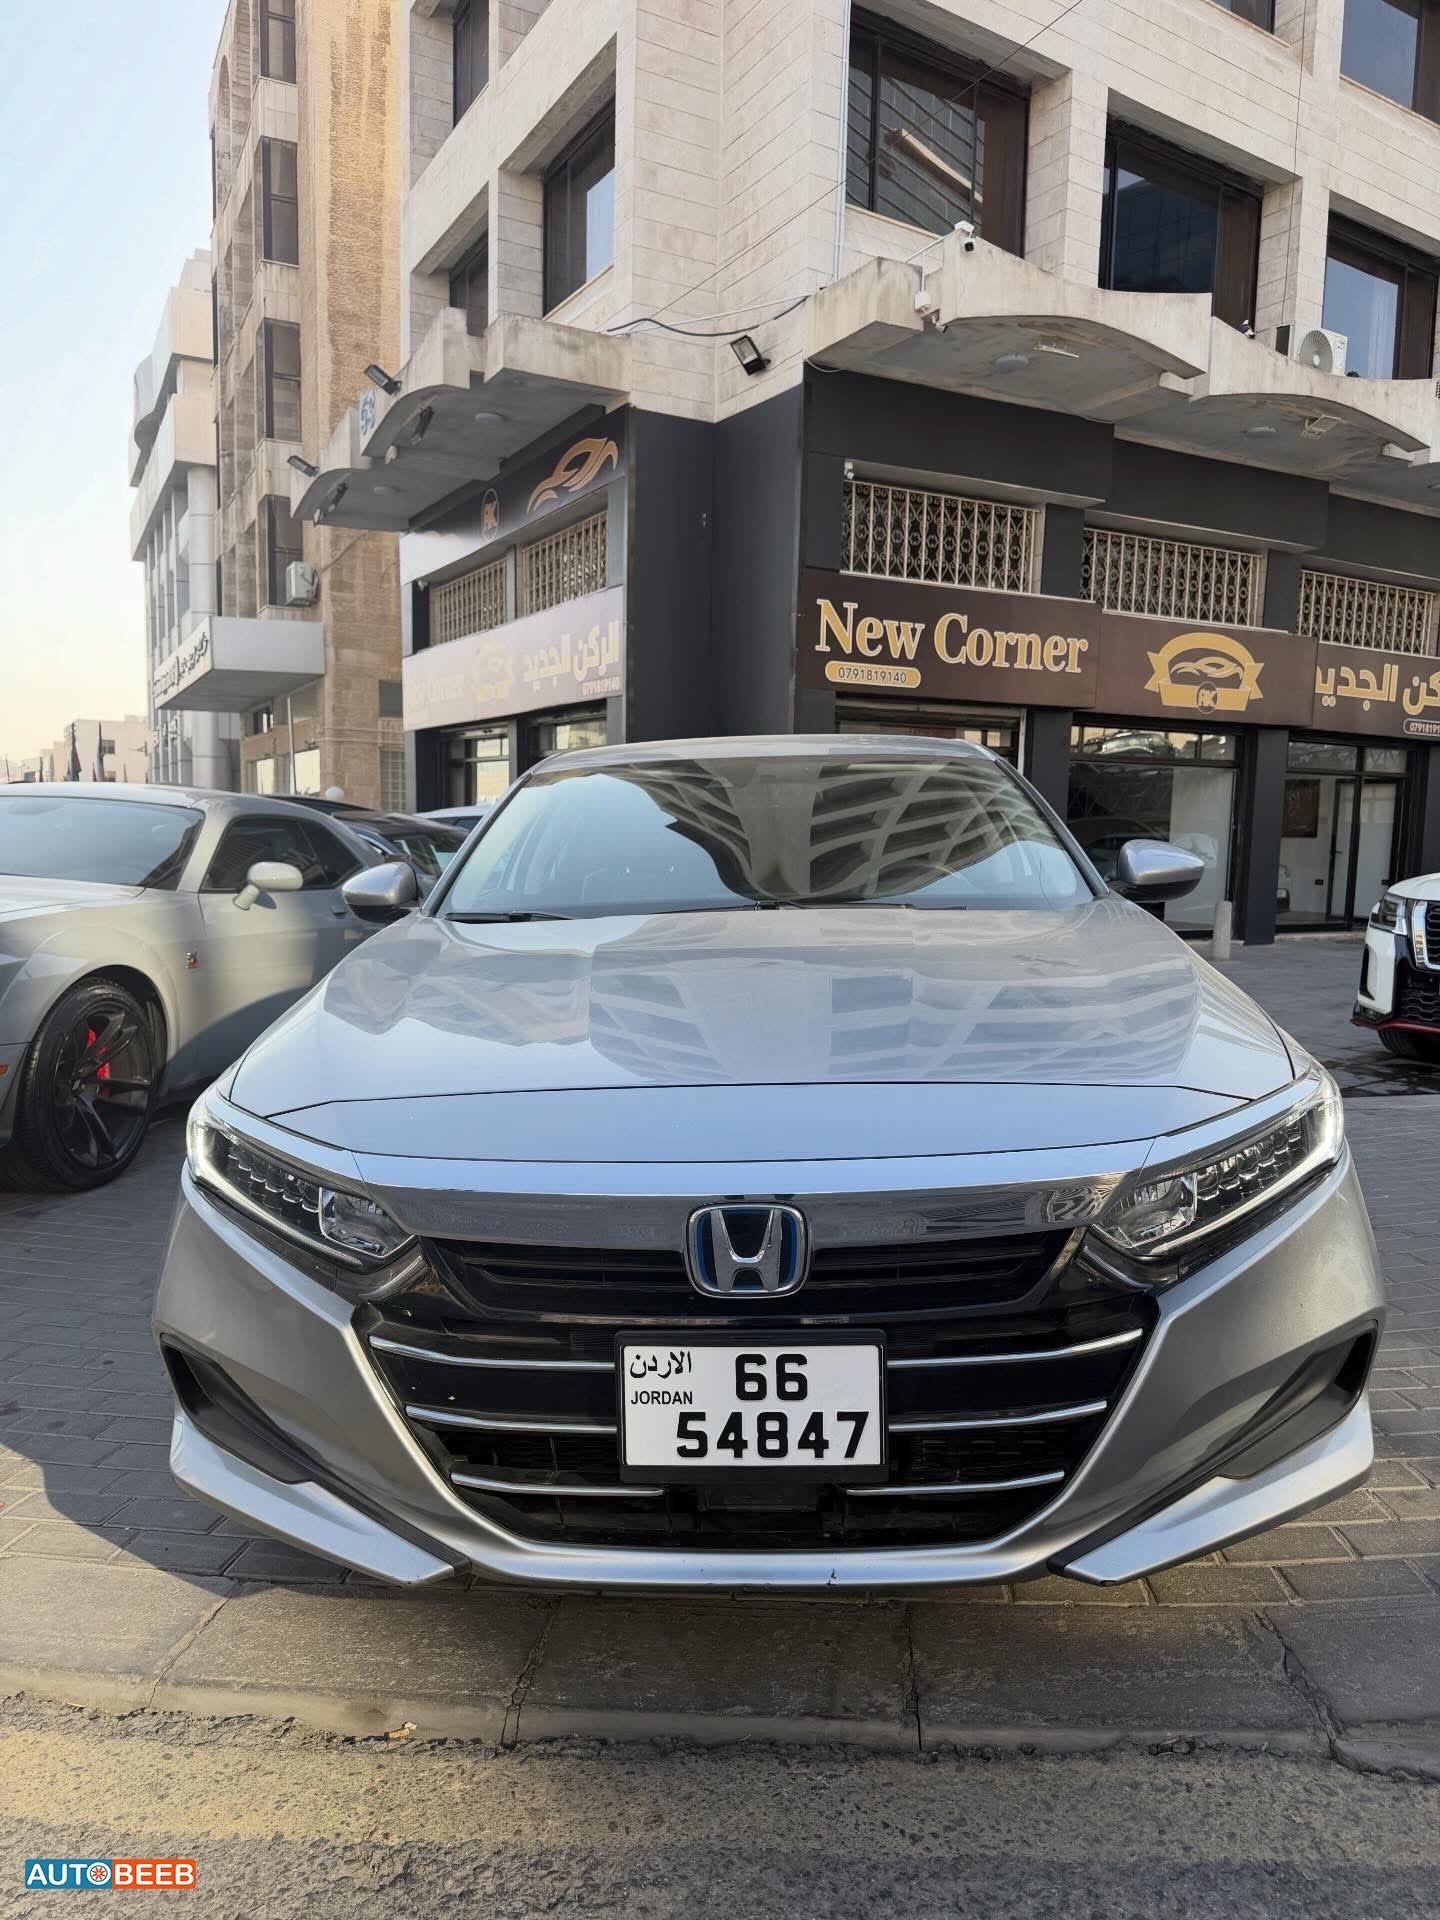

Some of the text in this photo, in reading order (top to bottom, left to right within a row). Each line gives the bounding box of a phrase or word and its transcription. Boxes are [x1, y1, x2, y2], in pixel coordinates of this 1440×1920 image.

[573, 621, 620, 681] الركن
[815, 599, 1089, 673] New Corner
[523, 633, 572, 693] الجديد
[838, 667, 907, 684] 0791819140
[631, 1390, 693, 1405] JORDAN
[735, 1353, 808, 1401] 66
[676, 1411, 870, 1459] 54847
